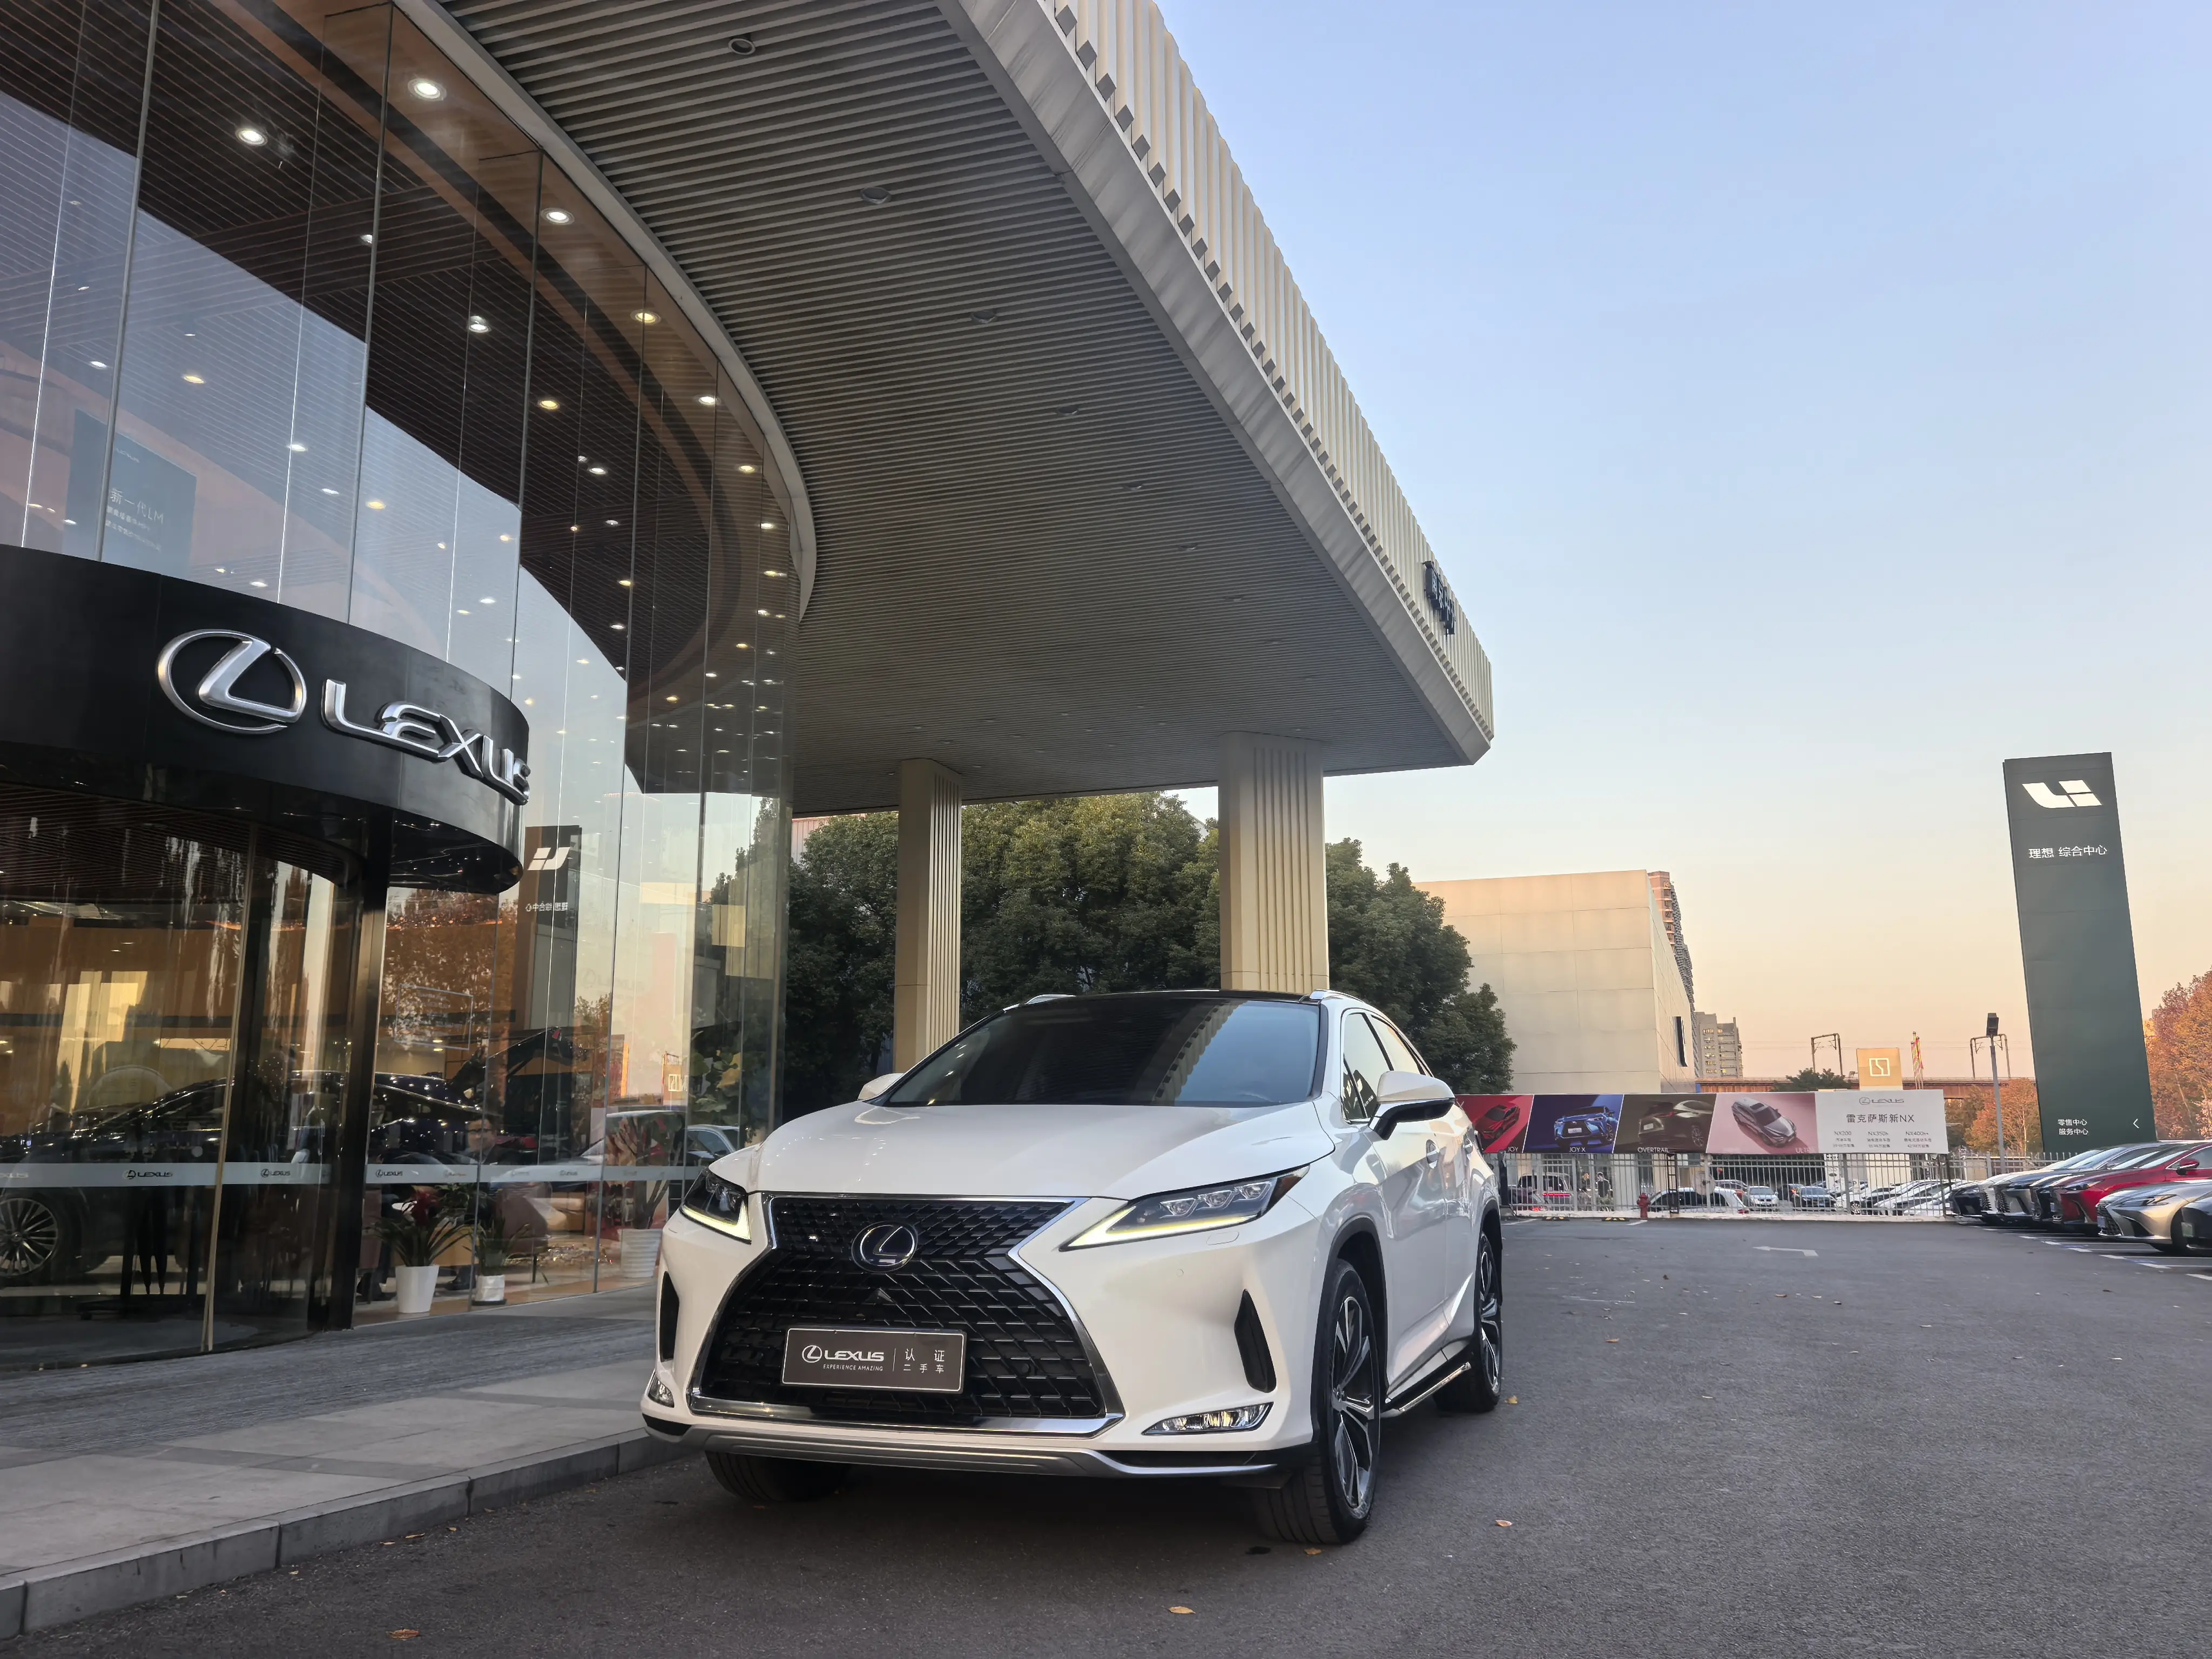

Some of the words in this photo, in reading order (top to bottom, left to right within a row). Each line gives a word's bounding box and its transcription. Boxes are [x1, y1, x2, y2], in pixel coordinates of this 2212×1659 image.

[322, 679, 530, 806] LEXUS
[2028, 847, 2054, 859] 理想
[2058, 845, 2108, 858] 综合中心
[1846, 1114, 1915, 1123] 雷克萨斯新NX
[824, 1350, 885, 1362] LEXUS
